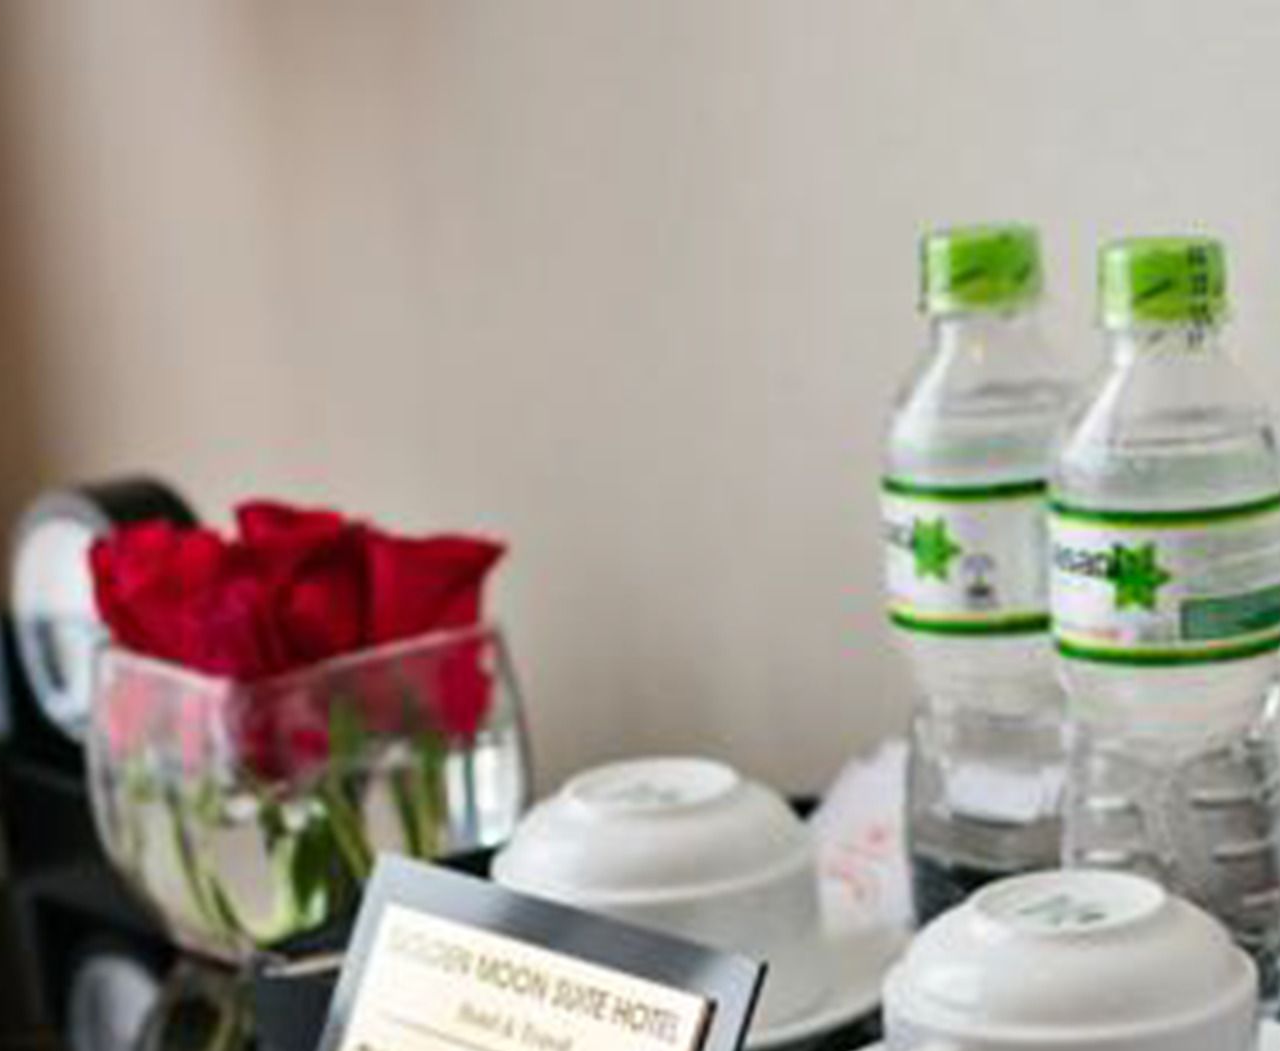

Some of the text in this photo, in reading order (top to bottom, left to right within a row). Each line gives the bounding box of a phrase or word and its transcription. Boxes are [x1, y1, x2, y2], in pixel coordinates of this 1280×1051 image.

[476, 954, 549, 1000] MOON
[552, 975, 609, 1019] SUITE
[613, 993, 682, 1043] HOTEL
